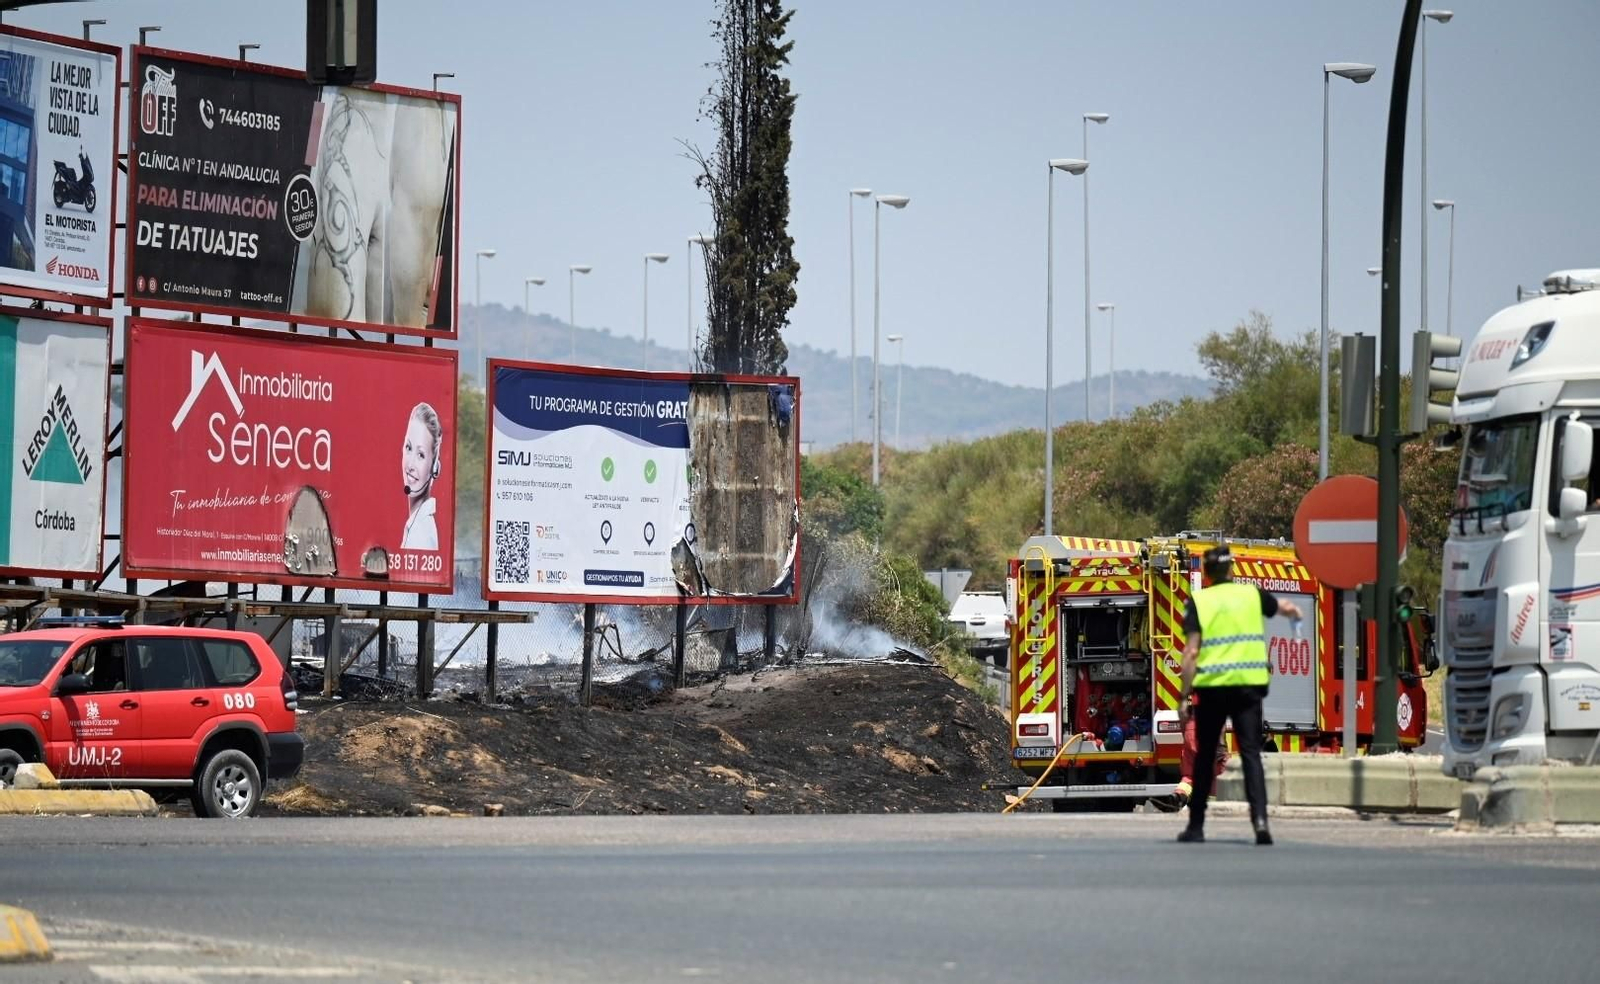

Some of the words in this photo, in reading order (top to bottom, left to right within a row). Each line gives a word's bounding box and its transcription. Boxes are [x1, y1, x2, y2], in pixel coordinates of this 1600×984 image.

[51, 61, 62, 83] LA
[63, 64, 91, 89] MEJOR
[50, 86, 75, 110] VISTA
[75, 92, 87, 113] DE
[88, 96, 99, 116] LA
[141, 88, 177, 136] OFF
[48, 111, 82, 139] CIUDAD.
[219, 108, 281, 131] 744603185
[138, 150, 180, 171] CLÍNICA
[197, 159, 202, 174] 1
[203, 160, 217, 177] EN
[137, 183, 178, 209] PARA
[181, 190, 278, 221] ELIMINACIÓN
[290, 189, 315, 213] 30€
[45, 213, 54, 226] EL
[56, 215, 96, 233] MOTORISTA
[292, 210, 315, 222] PRIMERA
[136, 220, 163, 248] DE
[168, 223, 259, 260] TATUAJES
[58, 263, 100, 281] HONDA
[163, 282, 172, 293] C/
[172, 283, 200, 295] Antonio
[201, 288, 222, 297] Maura
[223, 288, 232, 298] 57
[240, 290, 283, 304] tattoo-off.es
[239, 367, 332, 402] Inmobiliaria
[529, 395, 543, 411] TU
[544, 396, 598, 415] PROGRAMA
[600, 400, 612, 416] DE
[614, 401, 654, 419] GESTIÓN
[656, 400, 689, 419] GRAT
[22, 400, 57, 477] LEROY
[54, 384, 93, 482] MERLIN
[207, 409, 332, 472] Séneca
[170, 488, 186, 518] Tu
[187, 487, 258, 509] inmobiliaria
[259, 485, 272, 506] de
[502, 491, 512, 501] 957
[35, 509, 76, 531] Córdoba
[403, 554, 419, 571] 131
[420, 555, 442, 571] 280
[586, 573, 618, 582] GESTIONAMOS
[625, 575, 642, 584] AYUDA
[1263, 576, 1301, 592] CÓRDOBA
[1277, 637, 1310, 676] 080
[223, 692, 255, 710] 080
[69, 746, 121, 766] UMJ-2
